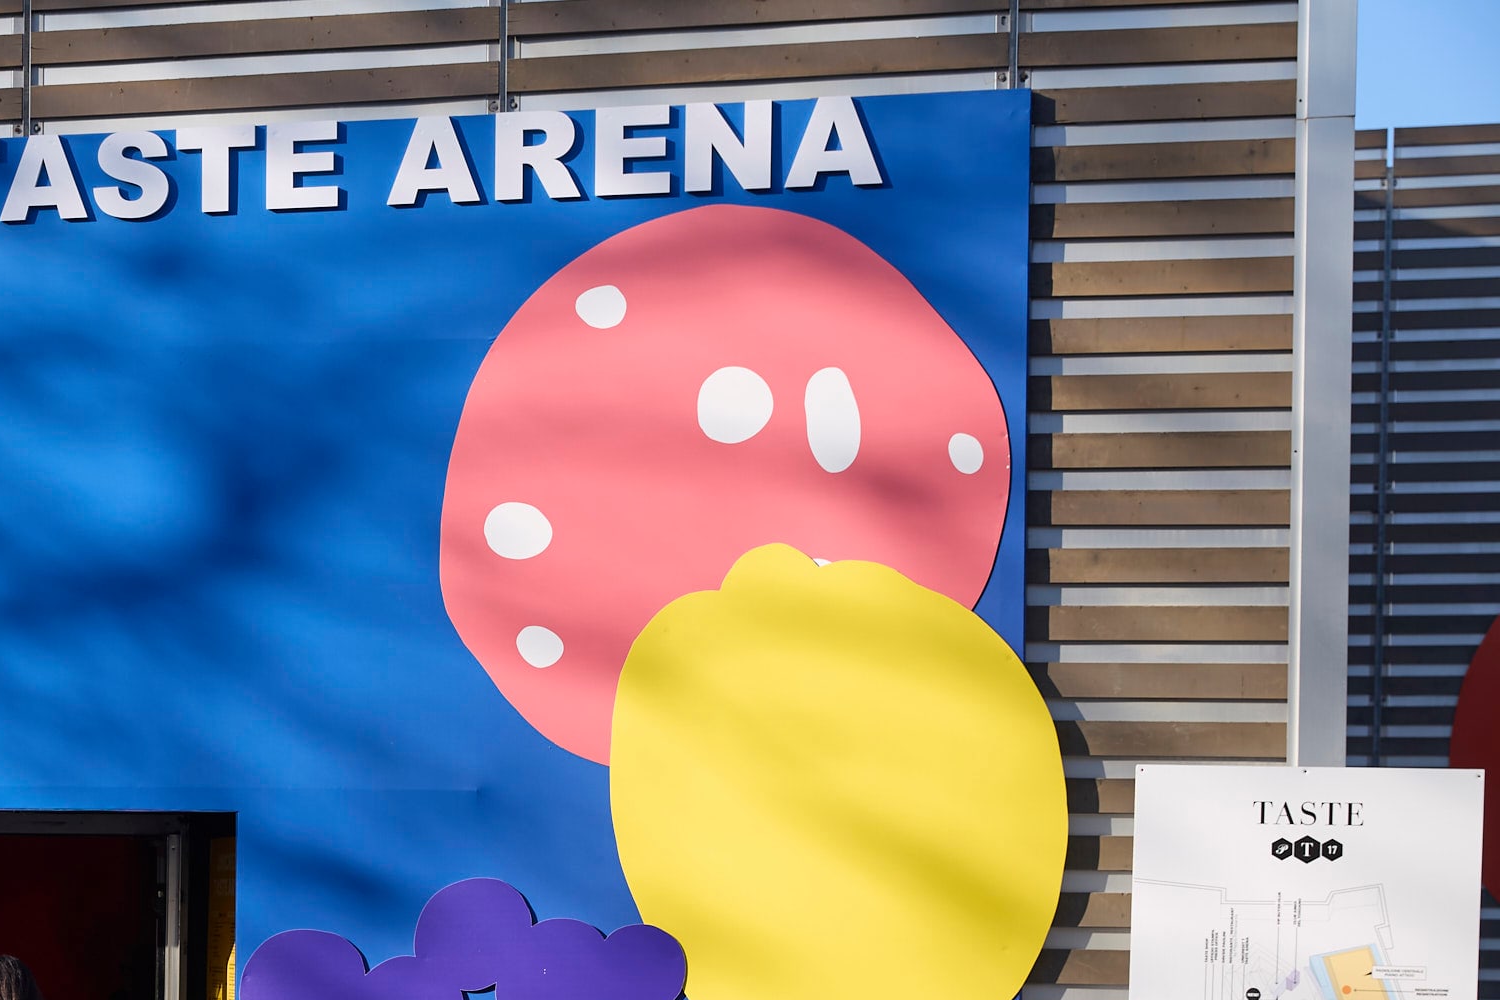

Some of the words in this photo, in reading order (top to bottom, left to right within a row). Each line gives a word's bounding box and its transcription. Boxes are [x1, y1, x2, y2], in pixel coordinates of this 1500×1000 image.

[387, 96, 883, 206] ARENA
[1253, 801, 1364, 826] TASTE
[1327, 845, 1338, 855] 17
